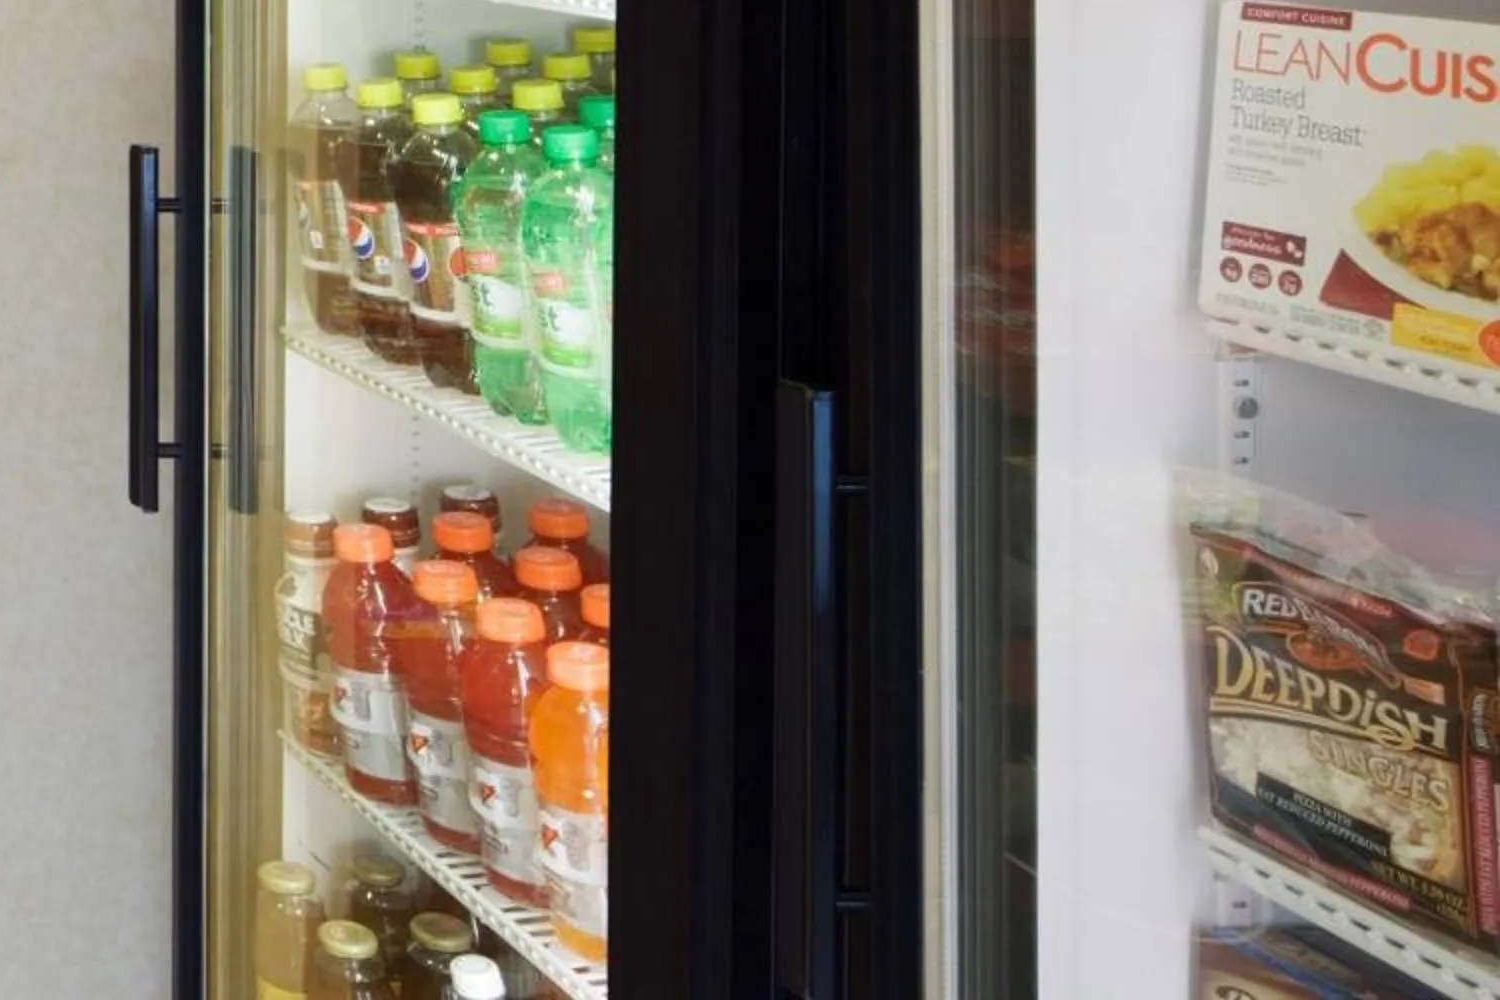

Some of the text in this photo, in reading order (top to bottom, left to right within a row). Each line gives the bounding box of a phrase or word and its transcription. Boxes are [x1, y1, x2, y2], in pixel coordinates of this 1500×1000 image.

[1233, 30, 1351, 87] LEAN
[1232, 78, 1307, 111] Roasted
[1230, 105, 1363, 148] Turkey Breast
[1307, 729, 1450, 813] SINGLES
